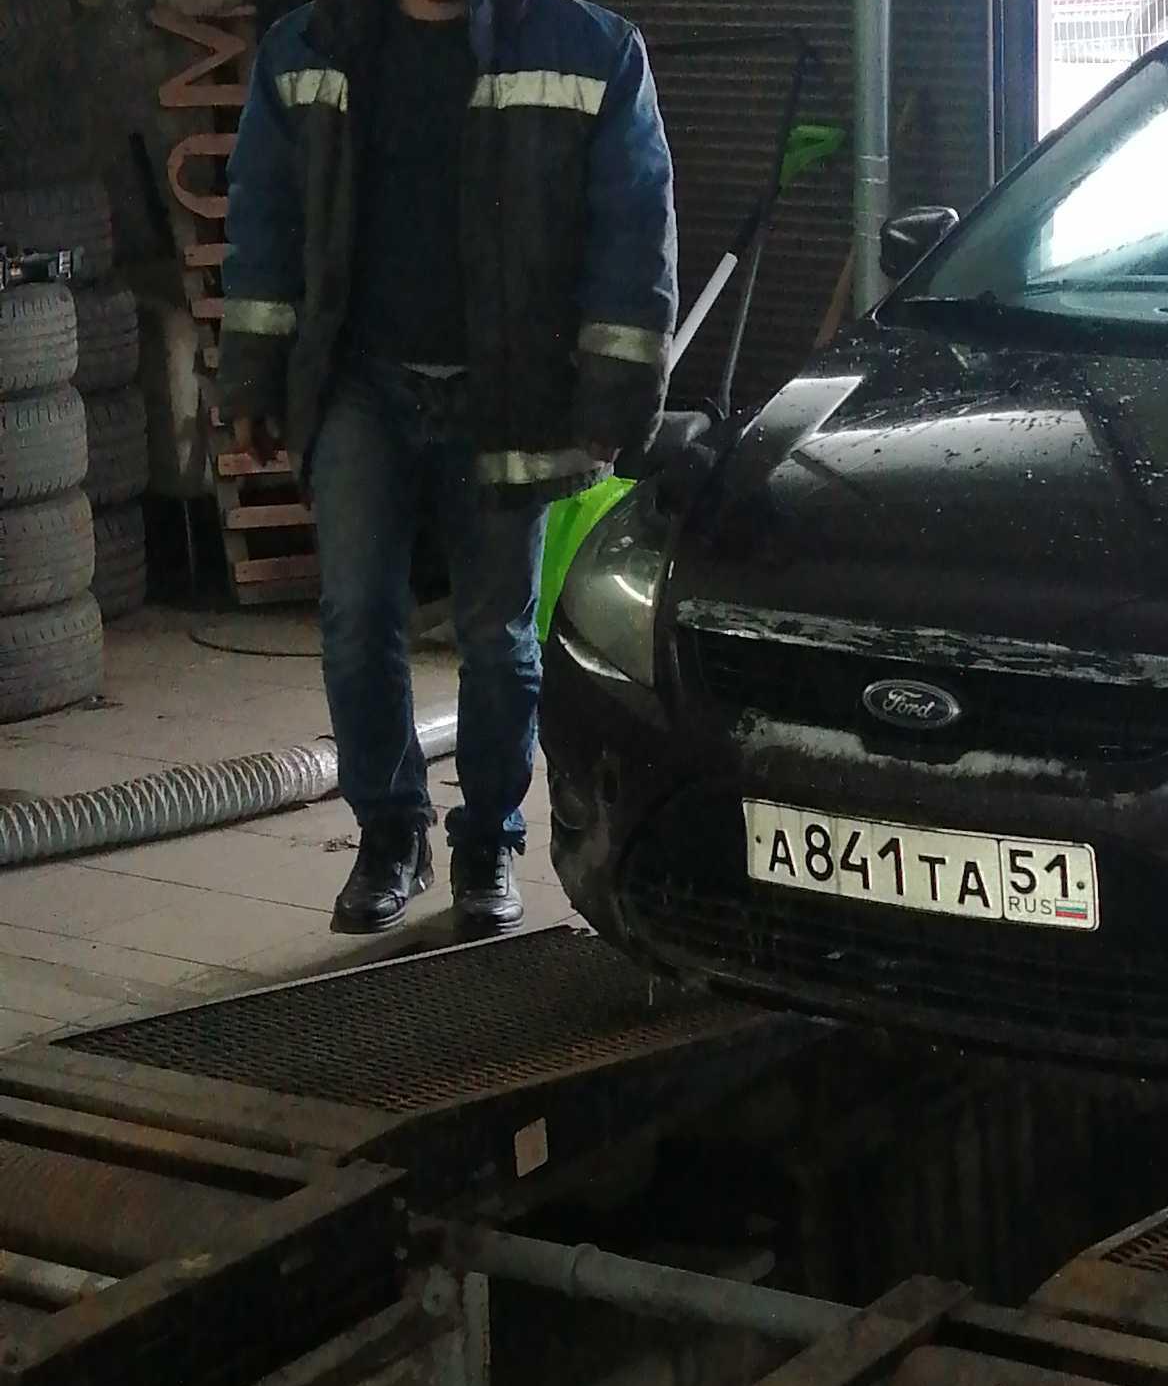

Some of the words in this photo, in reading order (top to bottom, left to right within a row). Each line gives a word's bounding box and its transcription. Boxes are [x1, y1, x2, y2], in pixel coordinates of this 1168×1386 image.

[883, 688, 935, 718] Ford
[767, 823, 991, 909] А841ТА
[1008, 849, 1070, 899] 51
[1008, 897, 1053, 915] RUS
